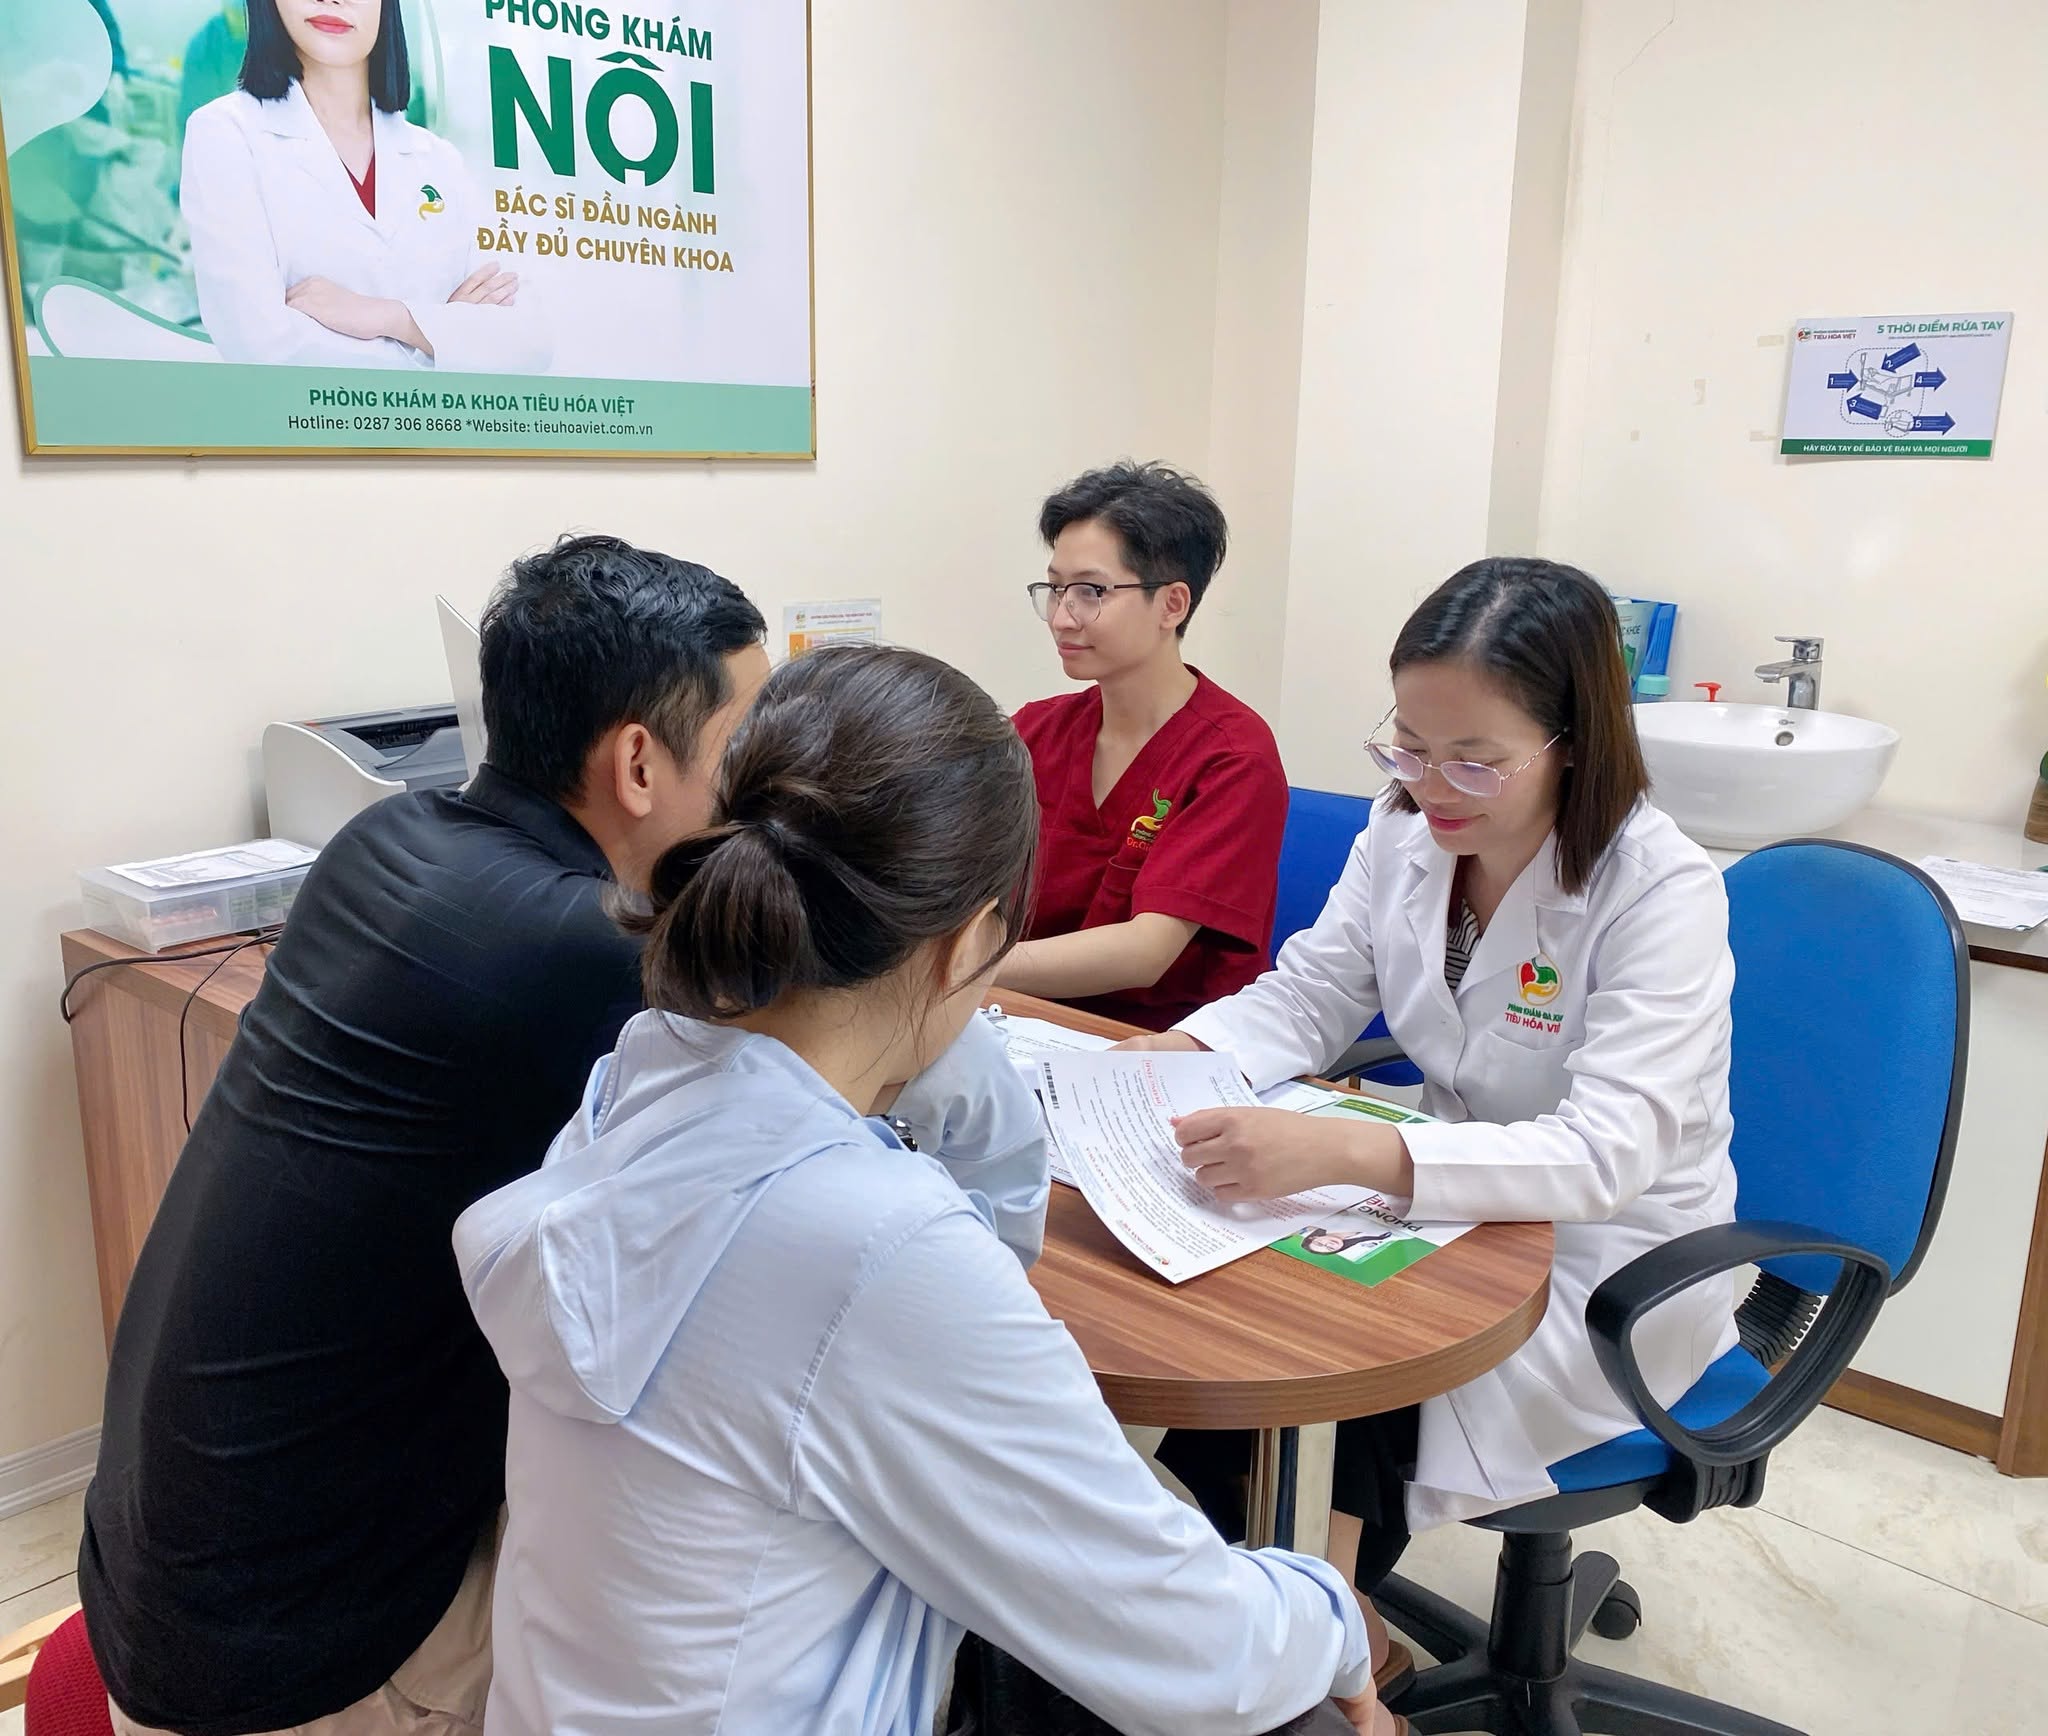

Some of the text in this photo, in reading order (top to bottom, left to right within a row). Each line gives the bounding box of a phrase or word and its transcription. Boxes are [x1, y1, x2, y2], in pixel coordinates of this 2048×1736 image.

[622, 14, 712, 61] KHÁM
[494, 185, 717, 235] BÁC SĨ ĐẦU NGÀNH
[476, 217, 734, 273] ĐẦY ĐỦ CHUYÊN KHOA
[1877, 319, 2005, 333] 5 THỜI ĐIỂM RỬA TAY
[1885, 360, 1894, 368] 2
[1830, 377, 1834, 385] 1
[1916, 375, 1923, 384] 4
[309, 386, 635, 417] PHÒNG KHÁM ĐA KHOA TIÊU HÓA VIỆT
[288, 415, 349, 430] Hotline:
[353, 416, 390, 430] 0287
[394, 417, 422, 431] 306
[425, 418, 462, 432] 8668
[534, 420, 653, 435] tieuhoaviet.com.vn
[1915, 420, 1922, 428] 5
[1522, 1017, 1544, 1031] HÓA
